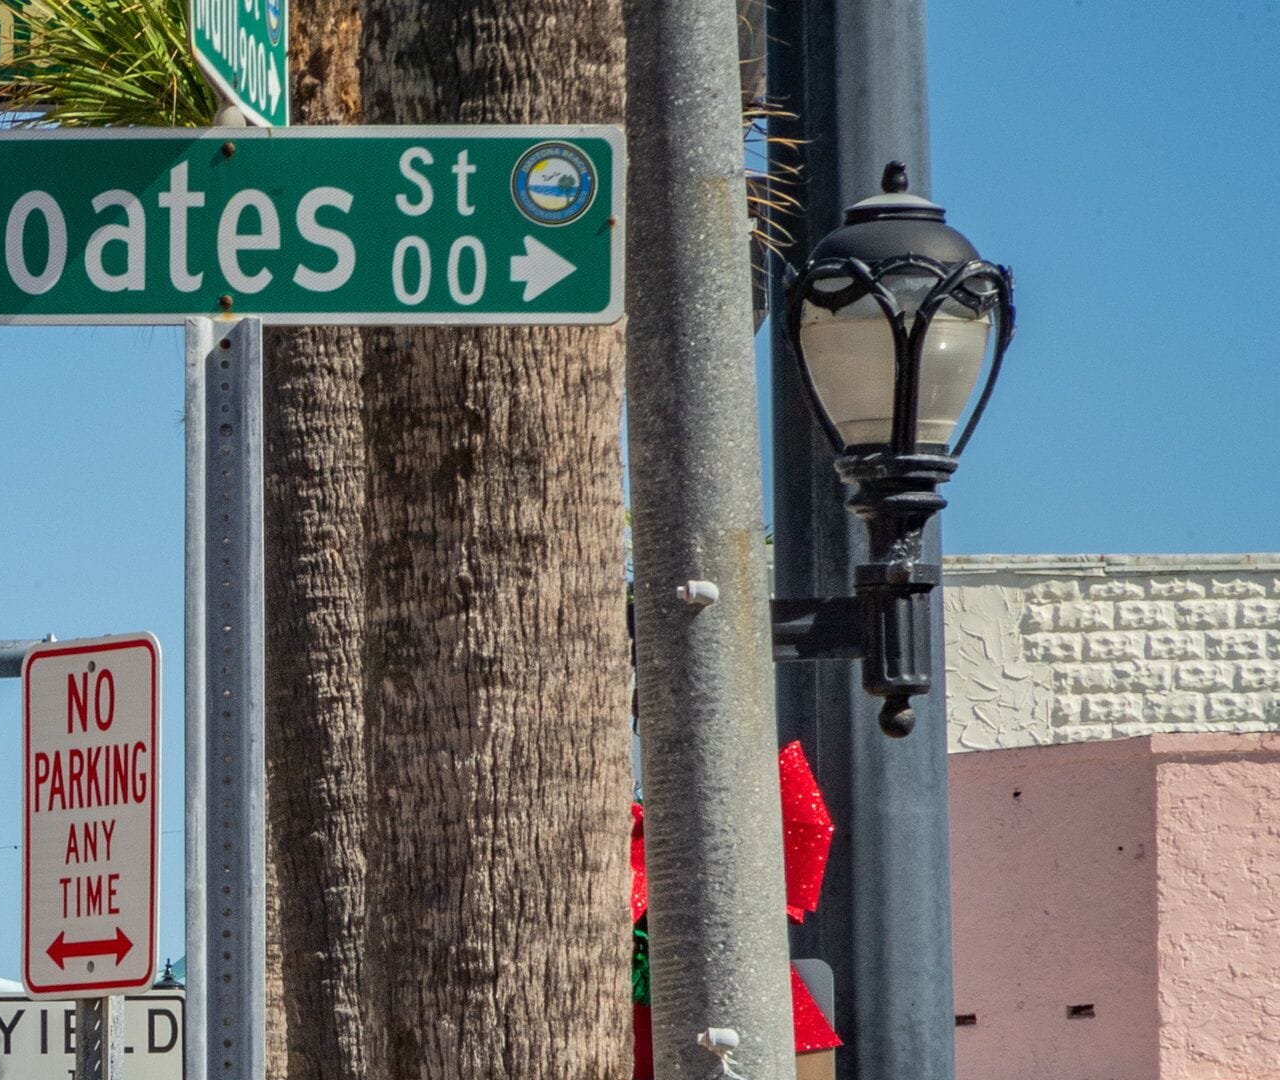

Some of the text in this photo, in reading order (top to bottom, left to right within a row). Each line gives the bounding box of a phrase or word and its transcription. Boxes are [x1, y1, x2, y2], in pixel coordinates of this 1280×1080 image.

[239, 26, 267, 111] 900
[396, 145, 478, 219] St
[391, 234, 488, 306] 00
[67, 668, 116, 735] NO
[34, 740, 147, 813] PARKING
[65, 819, 116, 865] ANY
[59, 873, 120, 919] TIME
